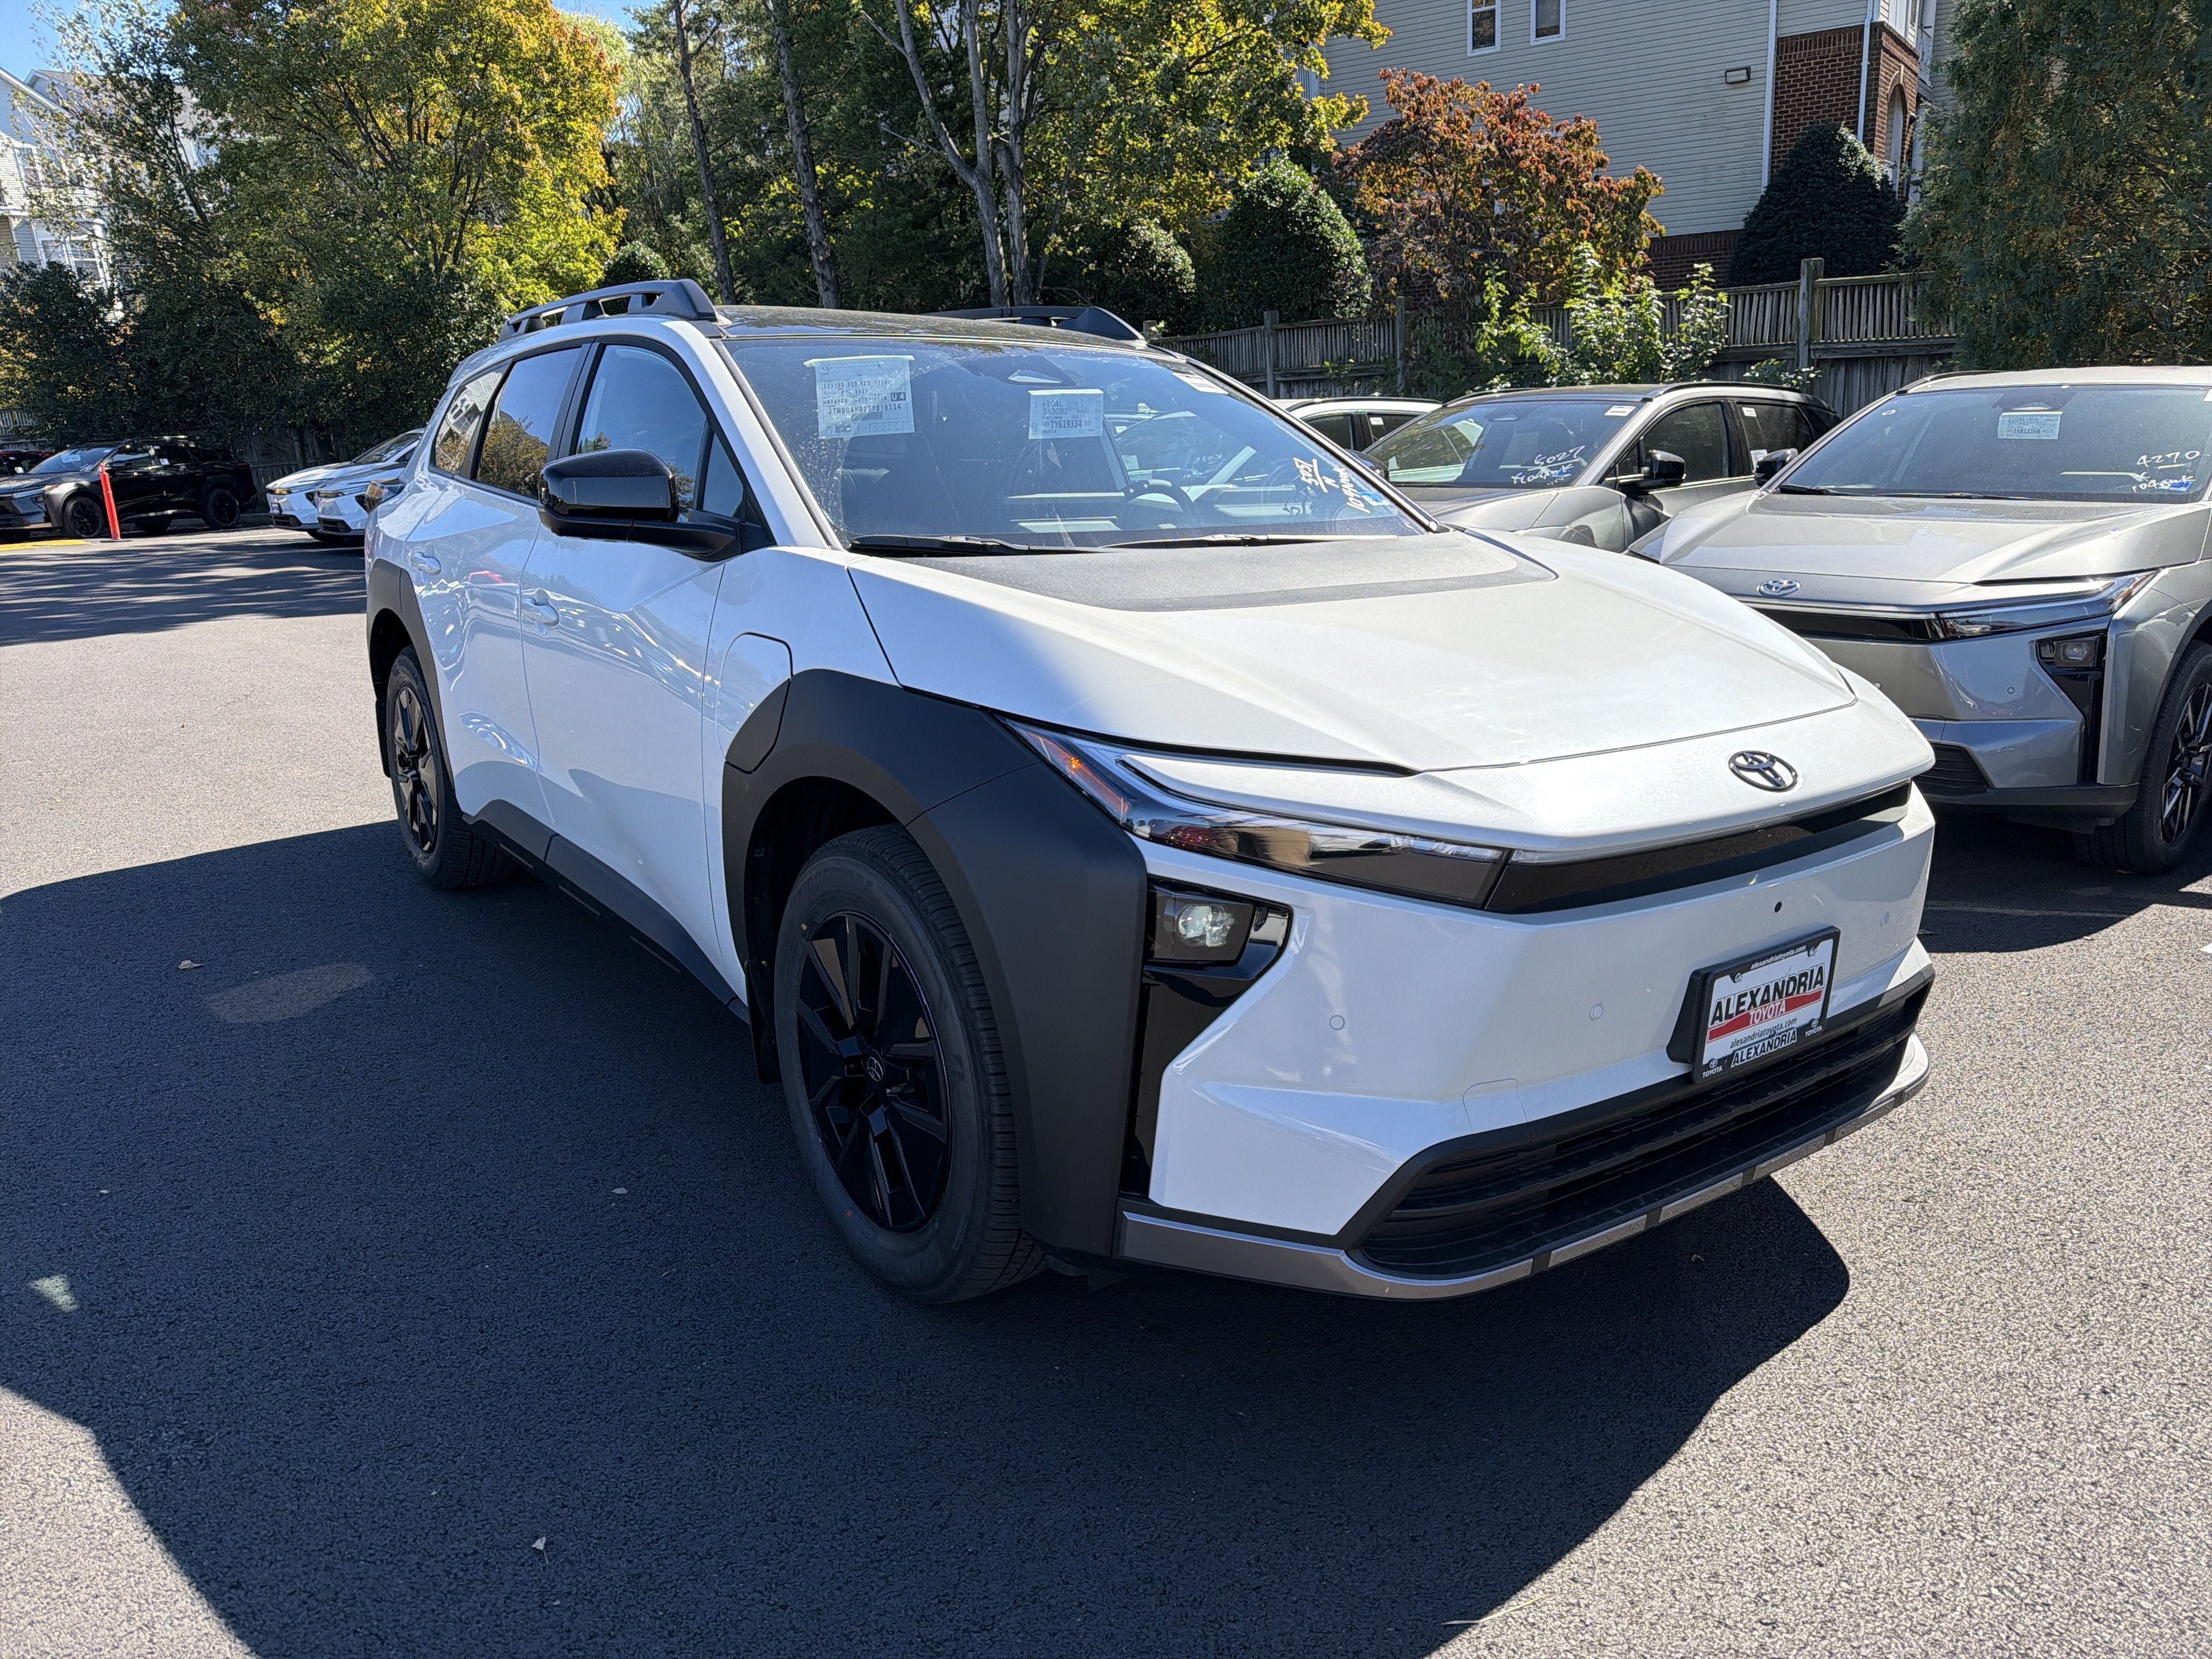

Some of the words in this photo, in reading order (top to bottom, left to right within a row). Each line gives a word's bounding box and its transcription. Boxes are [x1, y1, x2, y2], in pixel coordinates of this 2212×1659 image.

[1050, 419, 1082, 428] TY619334
[2136, 450, 2200, 467] 4270
[1751, 945, 1807, 969] alexandriatoyota.com
[1711, 964, 1824, 1026] ALEXANDRIA
[1749, 1001, 1787, 1026] TOYOTA
[1730, 1017, 1797, 1049] alexandriatoyota.com
[1805, 1025, 1823, 1037] TOYOTA
[1731, 1029, 1797, 1068] ALEXANDRIA
[1702, 1065, 1723, 1079] TOYOTA
